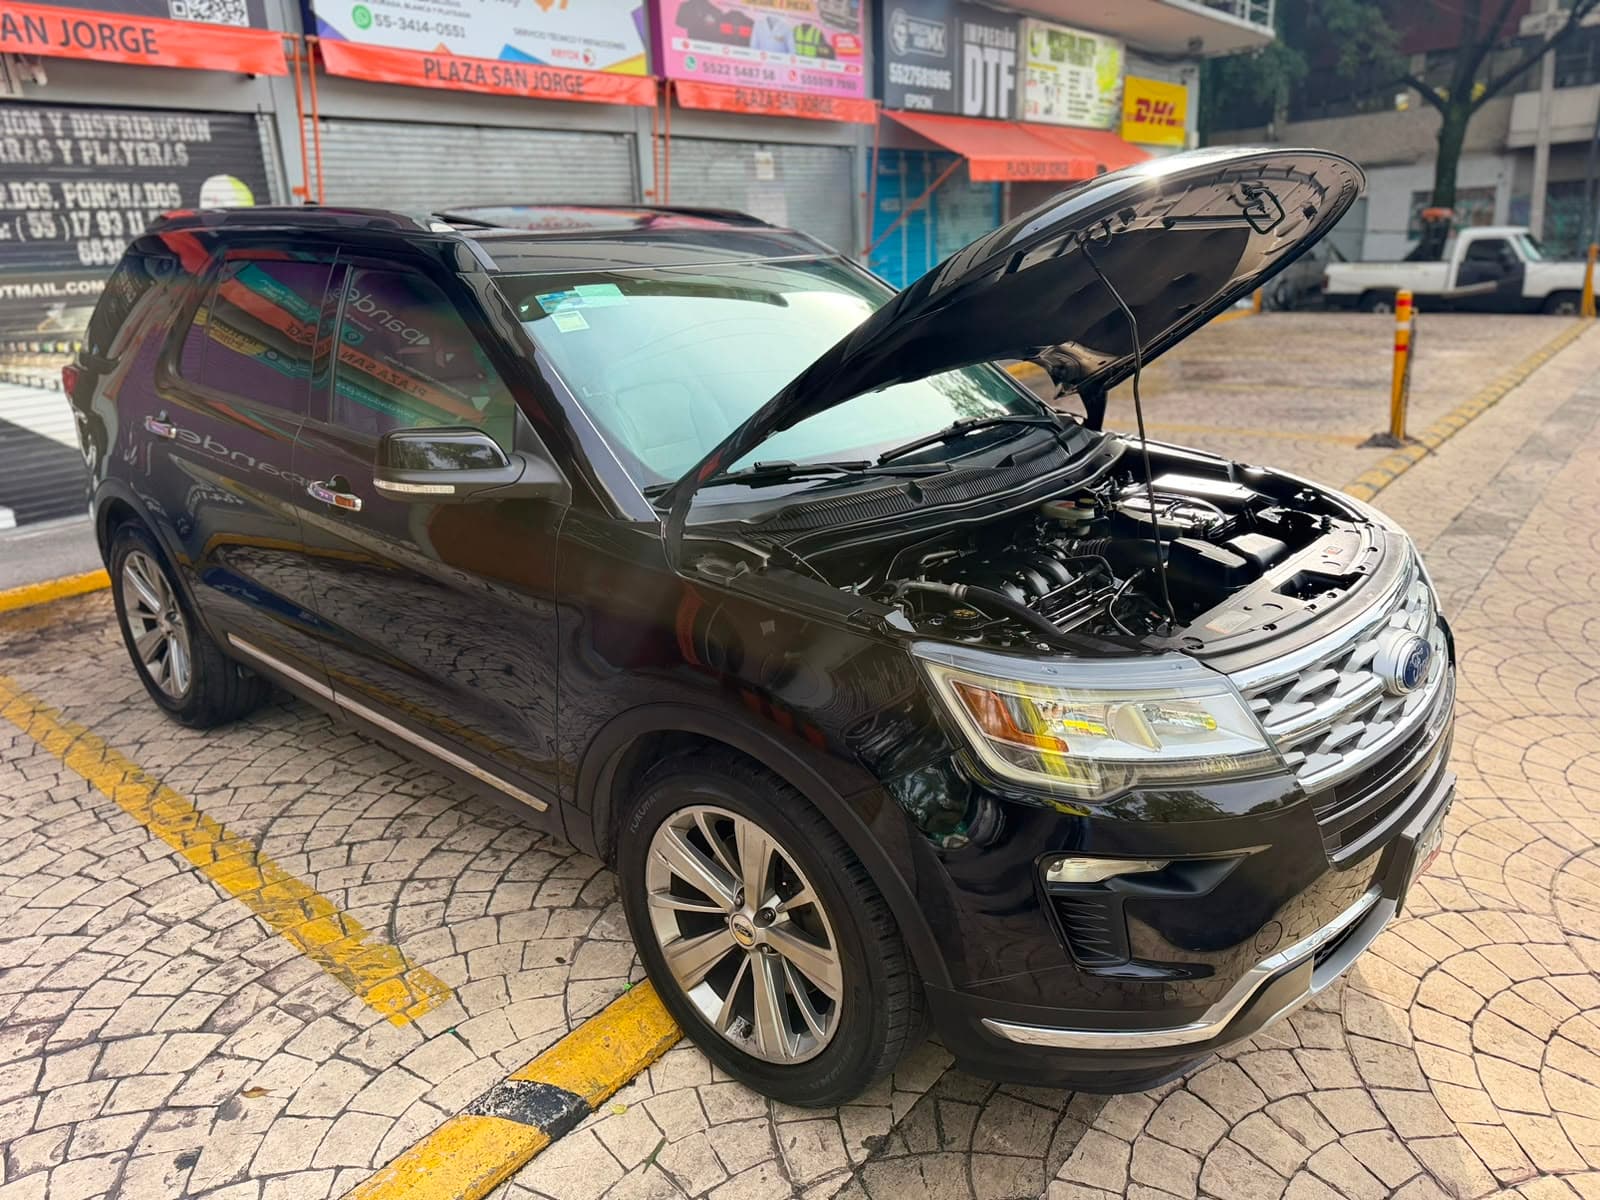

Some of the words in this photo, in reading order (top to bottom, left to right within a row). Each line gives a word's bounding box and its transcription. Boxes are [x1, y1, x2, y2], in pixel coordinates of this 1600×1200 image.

[1, 12, 48, 44] AN
[59, 19, 159, 54] JORGE
[374, 13, 466, 38] 55-3414-0551
[423, 57, 488, 85] PLAZA
[491, 66, 528, 89] SAN
[533, 71, 585, 95] JORGE
[964, 44, 1015, 117] DTF
[1135, 98, 1176, 126] DHL
[47, 112, 64, 137] Y
[70, 114, 211, 142] DISTRIBUCION
[56, 139, 73, 164] Y
[79, 140, 189, 167] PLAYERAS
[62, 183, 182, 209] PONCHADOS
